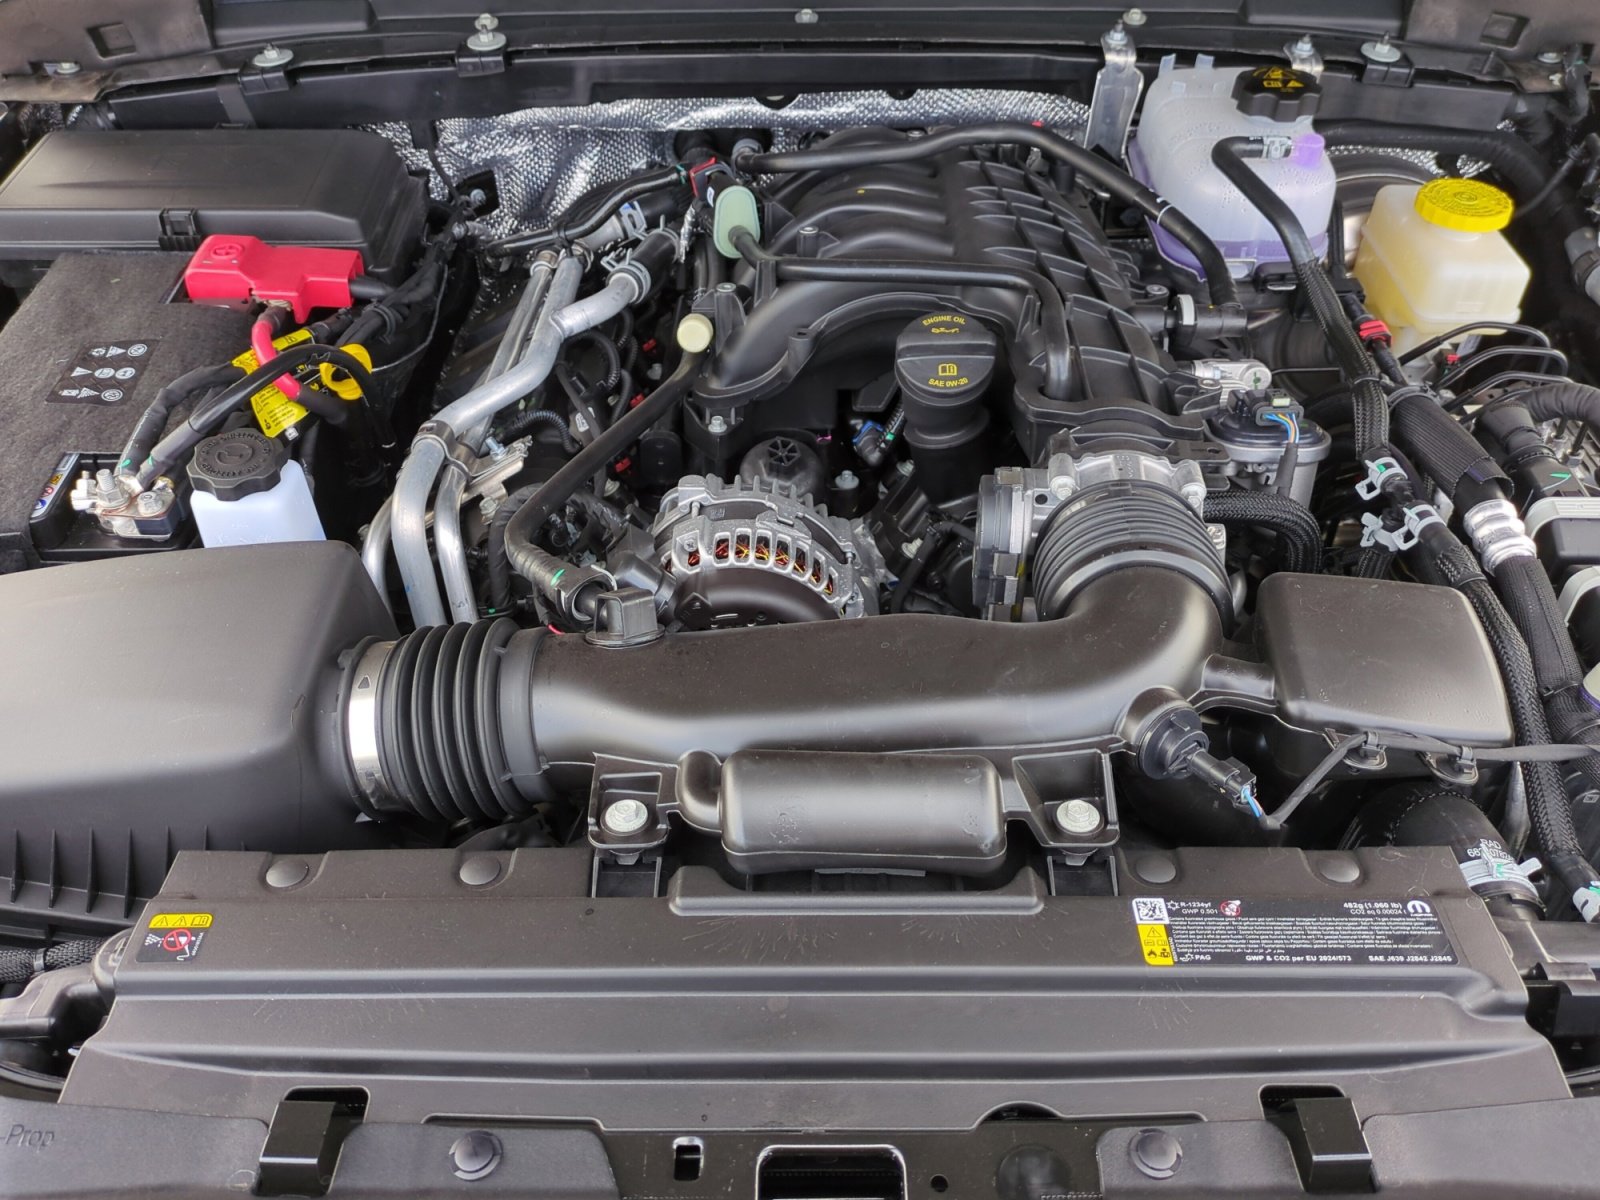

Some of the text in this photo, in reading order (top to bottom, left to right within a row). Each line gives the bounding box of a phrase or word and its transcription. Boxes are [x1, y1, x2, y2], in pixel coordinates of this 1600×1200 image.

[922, 315, 966, 326] ENGINE OIL
[928, 377, 969, 387] SAE 0W-20
[1180, 901, 1212, 909] R-1234yf
[1194, 954, 1212, 962] PAG
[1291, 955, 1305, 963] per
